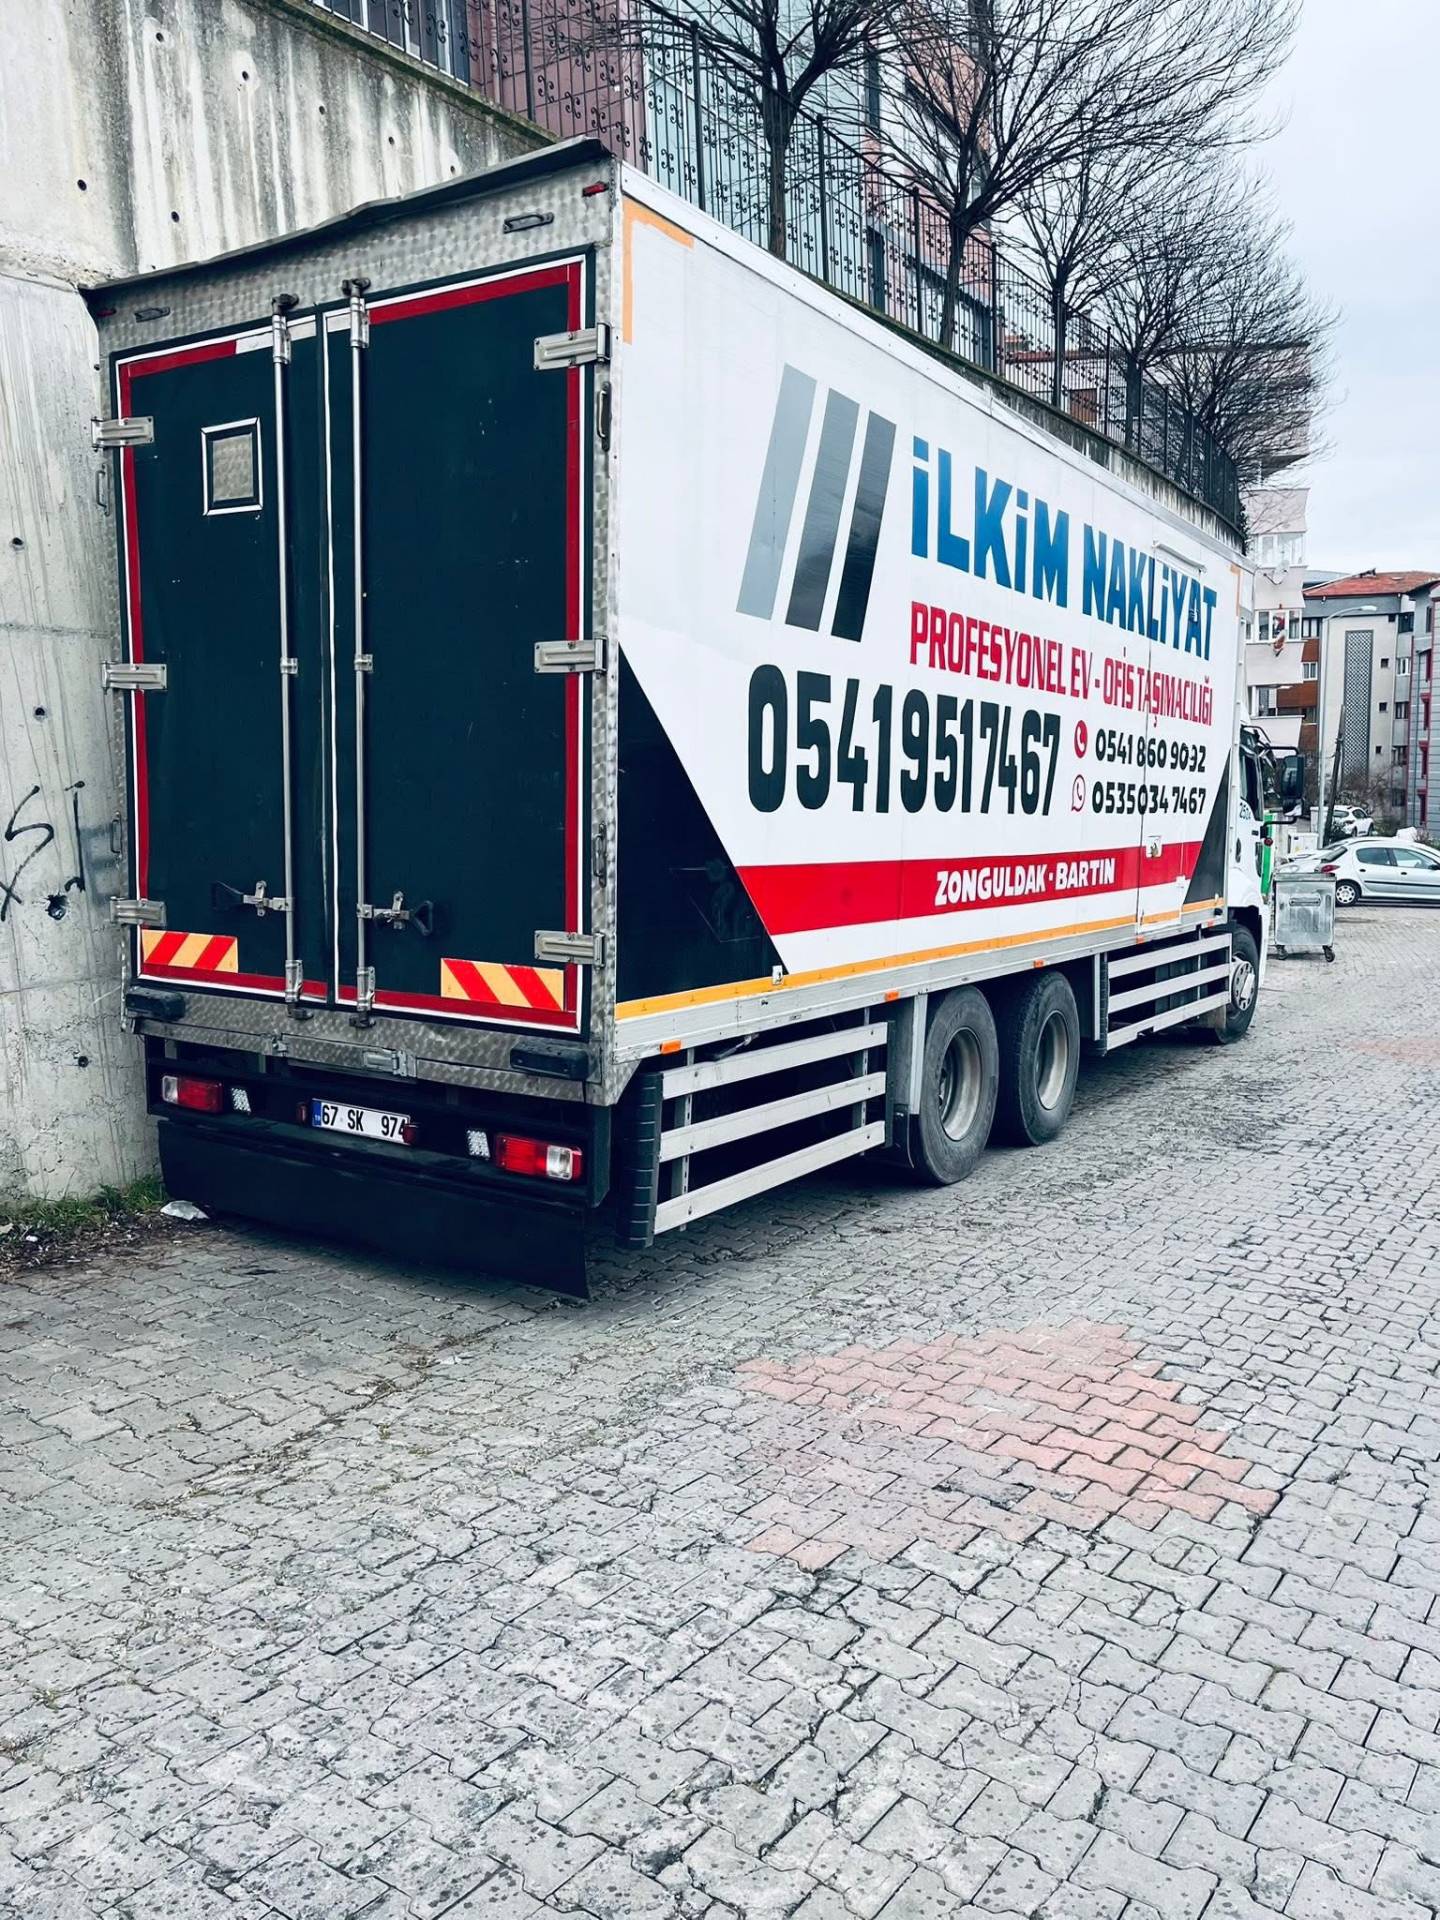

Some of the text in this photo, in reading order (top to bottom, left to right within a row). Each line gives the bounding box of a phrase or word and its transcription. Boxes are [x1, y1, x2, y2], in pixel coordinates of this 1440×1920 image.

[911, 434, 1218, 661] İLKİM NAKLİYAT
[909, 600, 1067, 696] PROFESYONEL
[1070, 647, 1093, 700] EV
[748, 663, 1061, 816] 05419517467
[1095, 728, 1133, 765] 0541
[1136, 735, 1167, 768] 860
[1171, 786, 1207, 815] 7467
[935, 863, 1048, 907] ZONGULDAK
[1055, 857, 1116, 891] BARTIN
[322, 1104, 339, 1127] 67
[347, 1109, 364, 1132] SK
